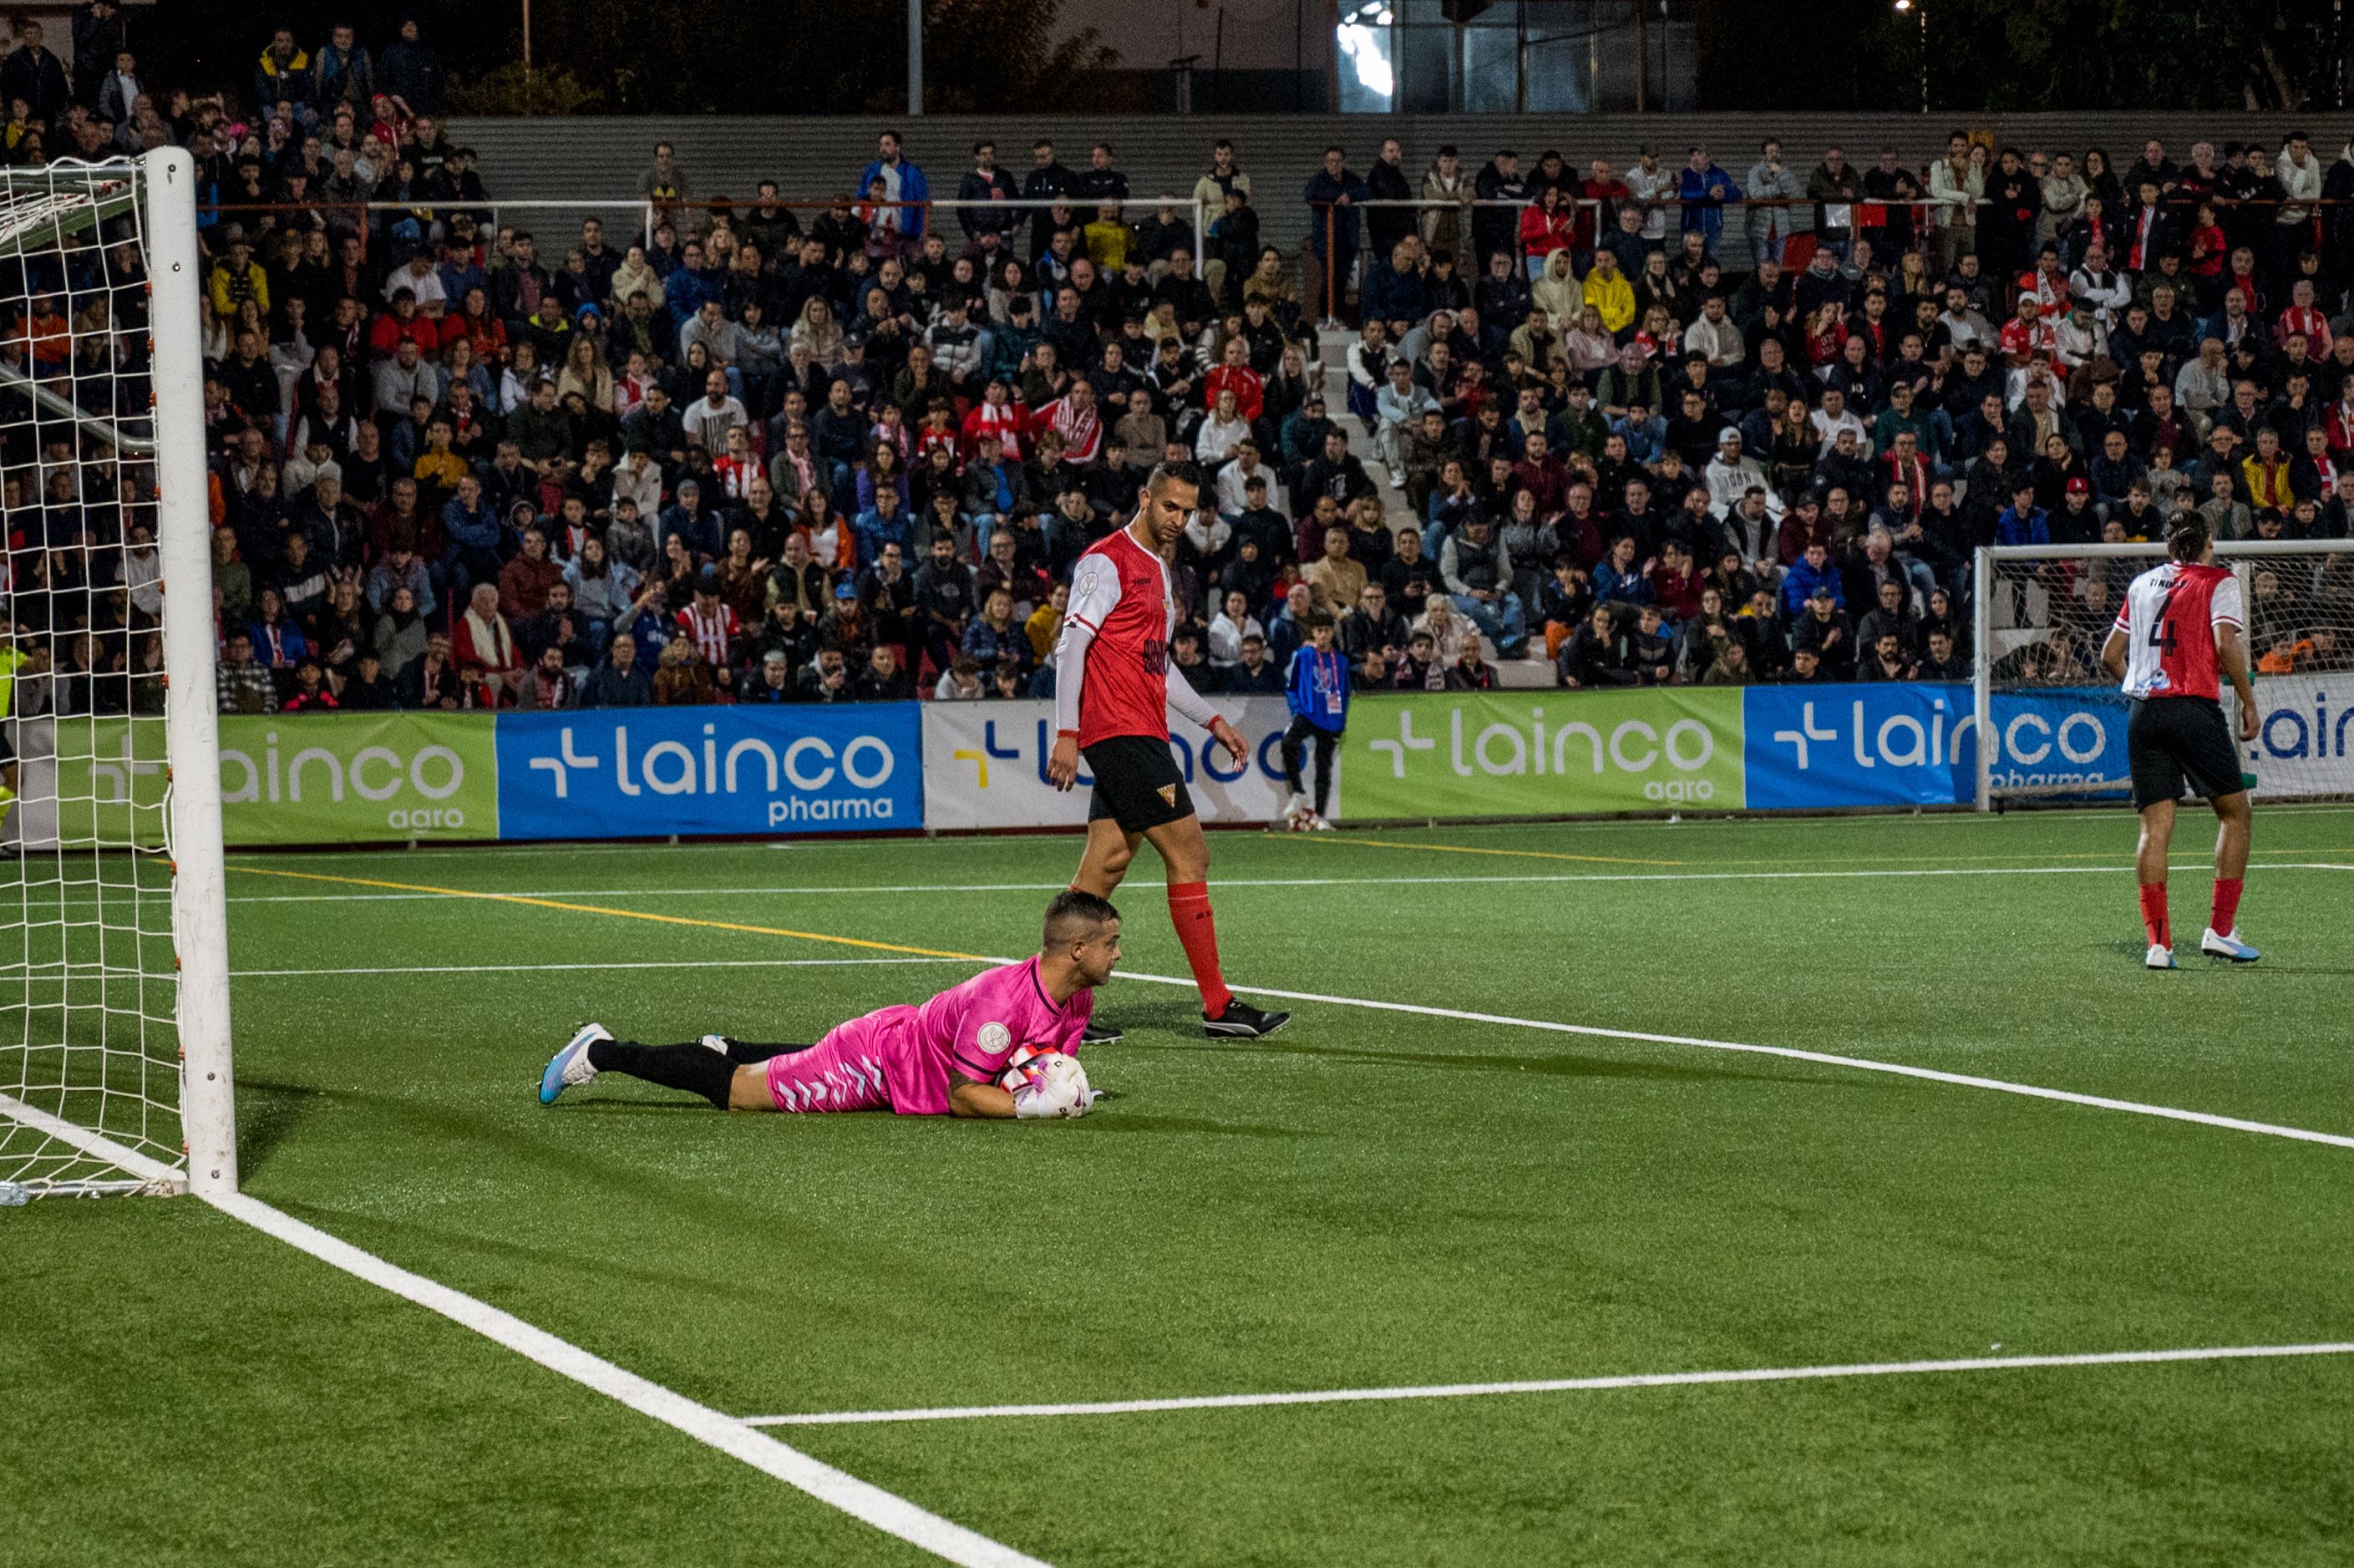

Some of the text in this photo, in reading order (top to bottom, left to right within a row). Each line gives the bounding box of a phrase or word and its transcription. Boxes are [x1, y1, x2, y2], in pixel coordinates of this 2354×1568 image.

[2148, 591, 2179, 657] 4
[616, 723, 895, 796] lainco
[1452, 708, 1714, 776] lainco
[1853, 698, 2106, 767] lainco
[219, 732, 464, 803] ainco
[1644, 779, 1714, 802] agro
[387, 808, 464, 831] agro
[769, 795, 893, 826] pharma
